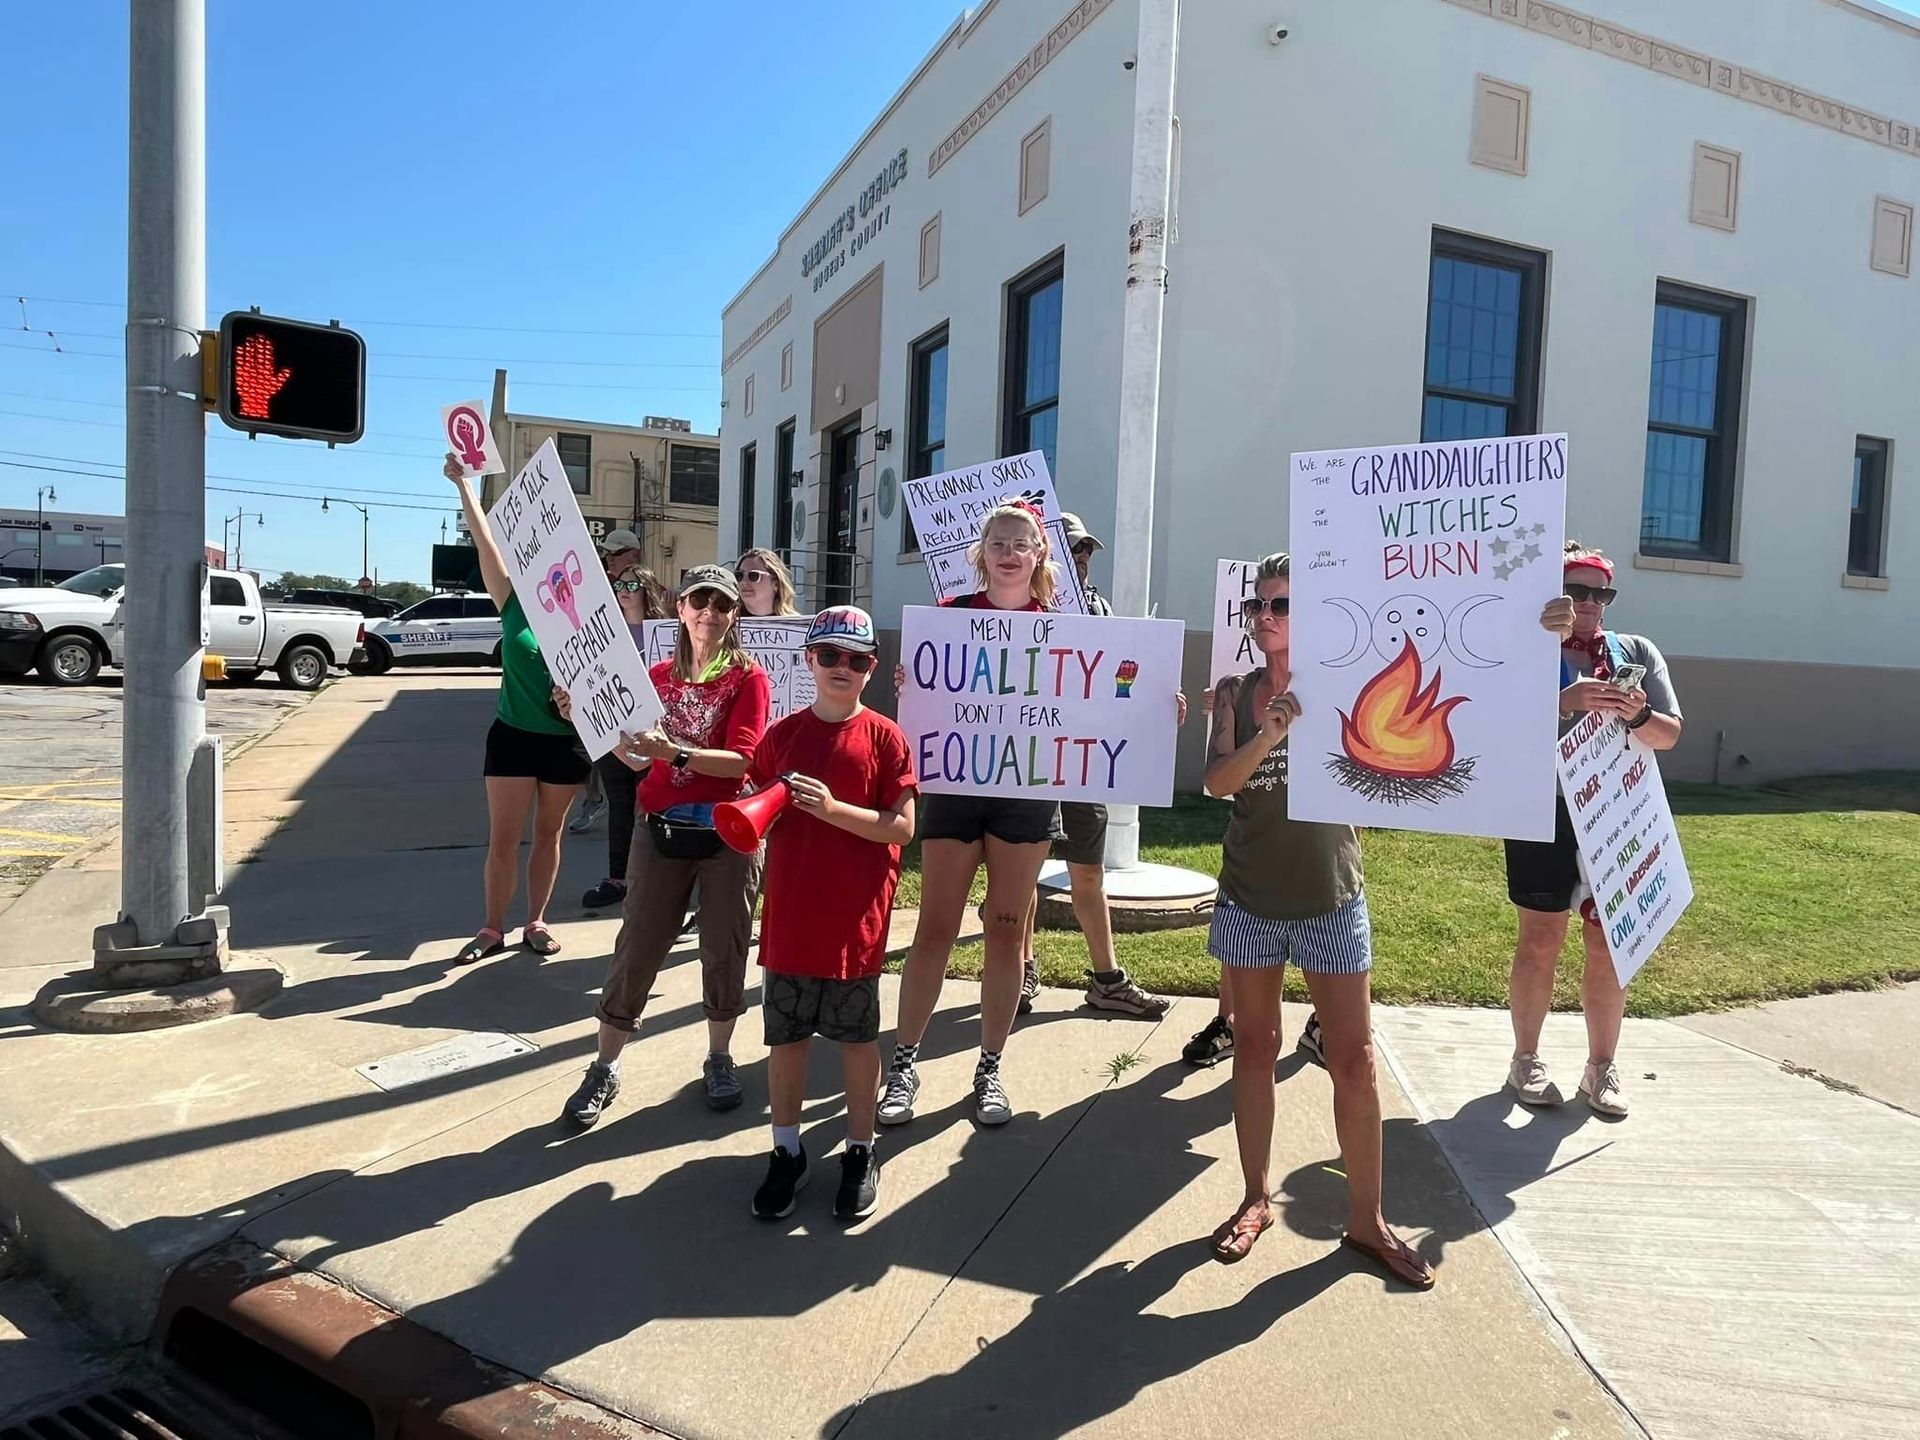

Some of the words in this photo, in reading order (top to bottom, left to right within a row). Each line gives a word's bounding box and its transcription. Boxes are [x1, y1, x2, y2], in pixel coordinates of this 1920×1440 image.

[801, 205, 856, 278] SHERIFF'S
[859, 147, 908, 219] OFFICE
[850, 204, 891, 257] COUNTY
[519, 460, 550, 505] TALK
[908, 470, 985, 508] PREGNANCY
[991, 457, 1036, 488] STARTS
[1299, 459, 1318, 472] WE
[1325, 457, 1346, 469] ARE
[1351, 438, 1567, 496] GRANDDAUGHTERS
[1311, 475, 1331, 486] THE
[922, 518, 983, 549] REGULAT
[1312, 519, 1329, 527] THE
[1315, 508, 1326, 517] OF
[1378, 494, 1519, 538] WITCHES
[1383, 539, 1479, 580] BURN
[401, 632, 450, 643] SHERIFF
[555, 603, 616, 690] ELEPHANT
[971, 617, 1012, 642] MEN
[1033, 618, 1055, 644] OF
[586, 674, 596, 691] IN
[913, 639, 1105, 699] QUALITY
[582, 673, 635, 739] WOMB
[955, 702, 1005, 725] DON'T
[1020, 705, 1062, 727] FEAR
[919, 731, 1128, 789] EQUALITY
[1622, 754, 1647, 797] FORCE
[1574, 773, 1602, 812] POWER
[1611, 912, 1637, 949] CIVIL
